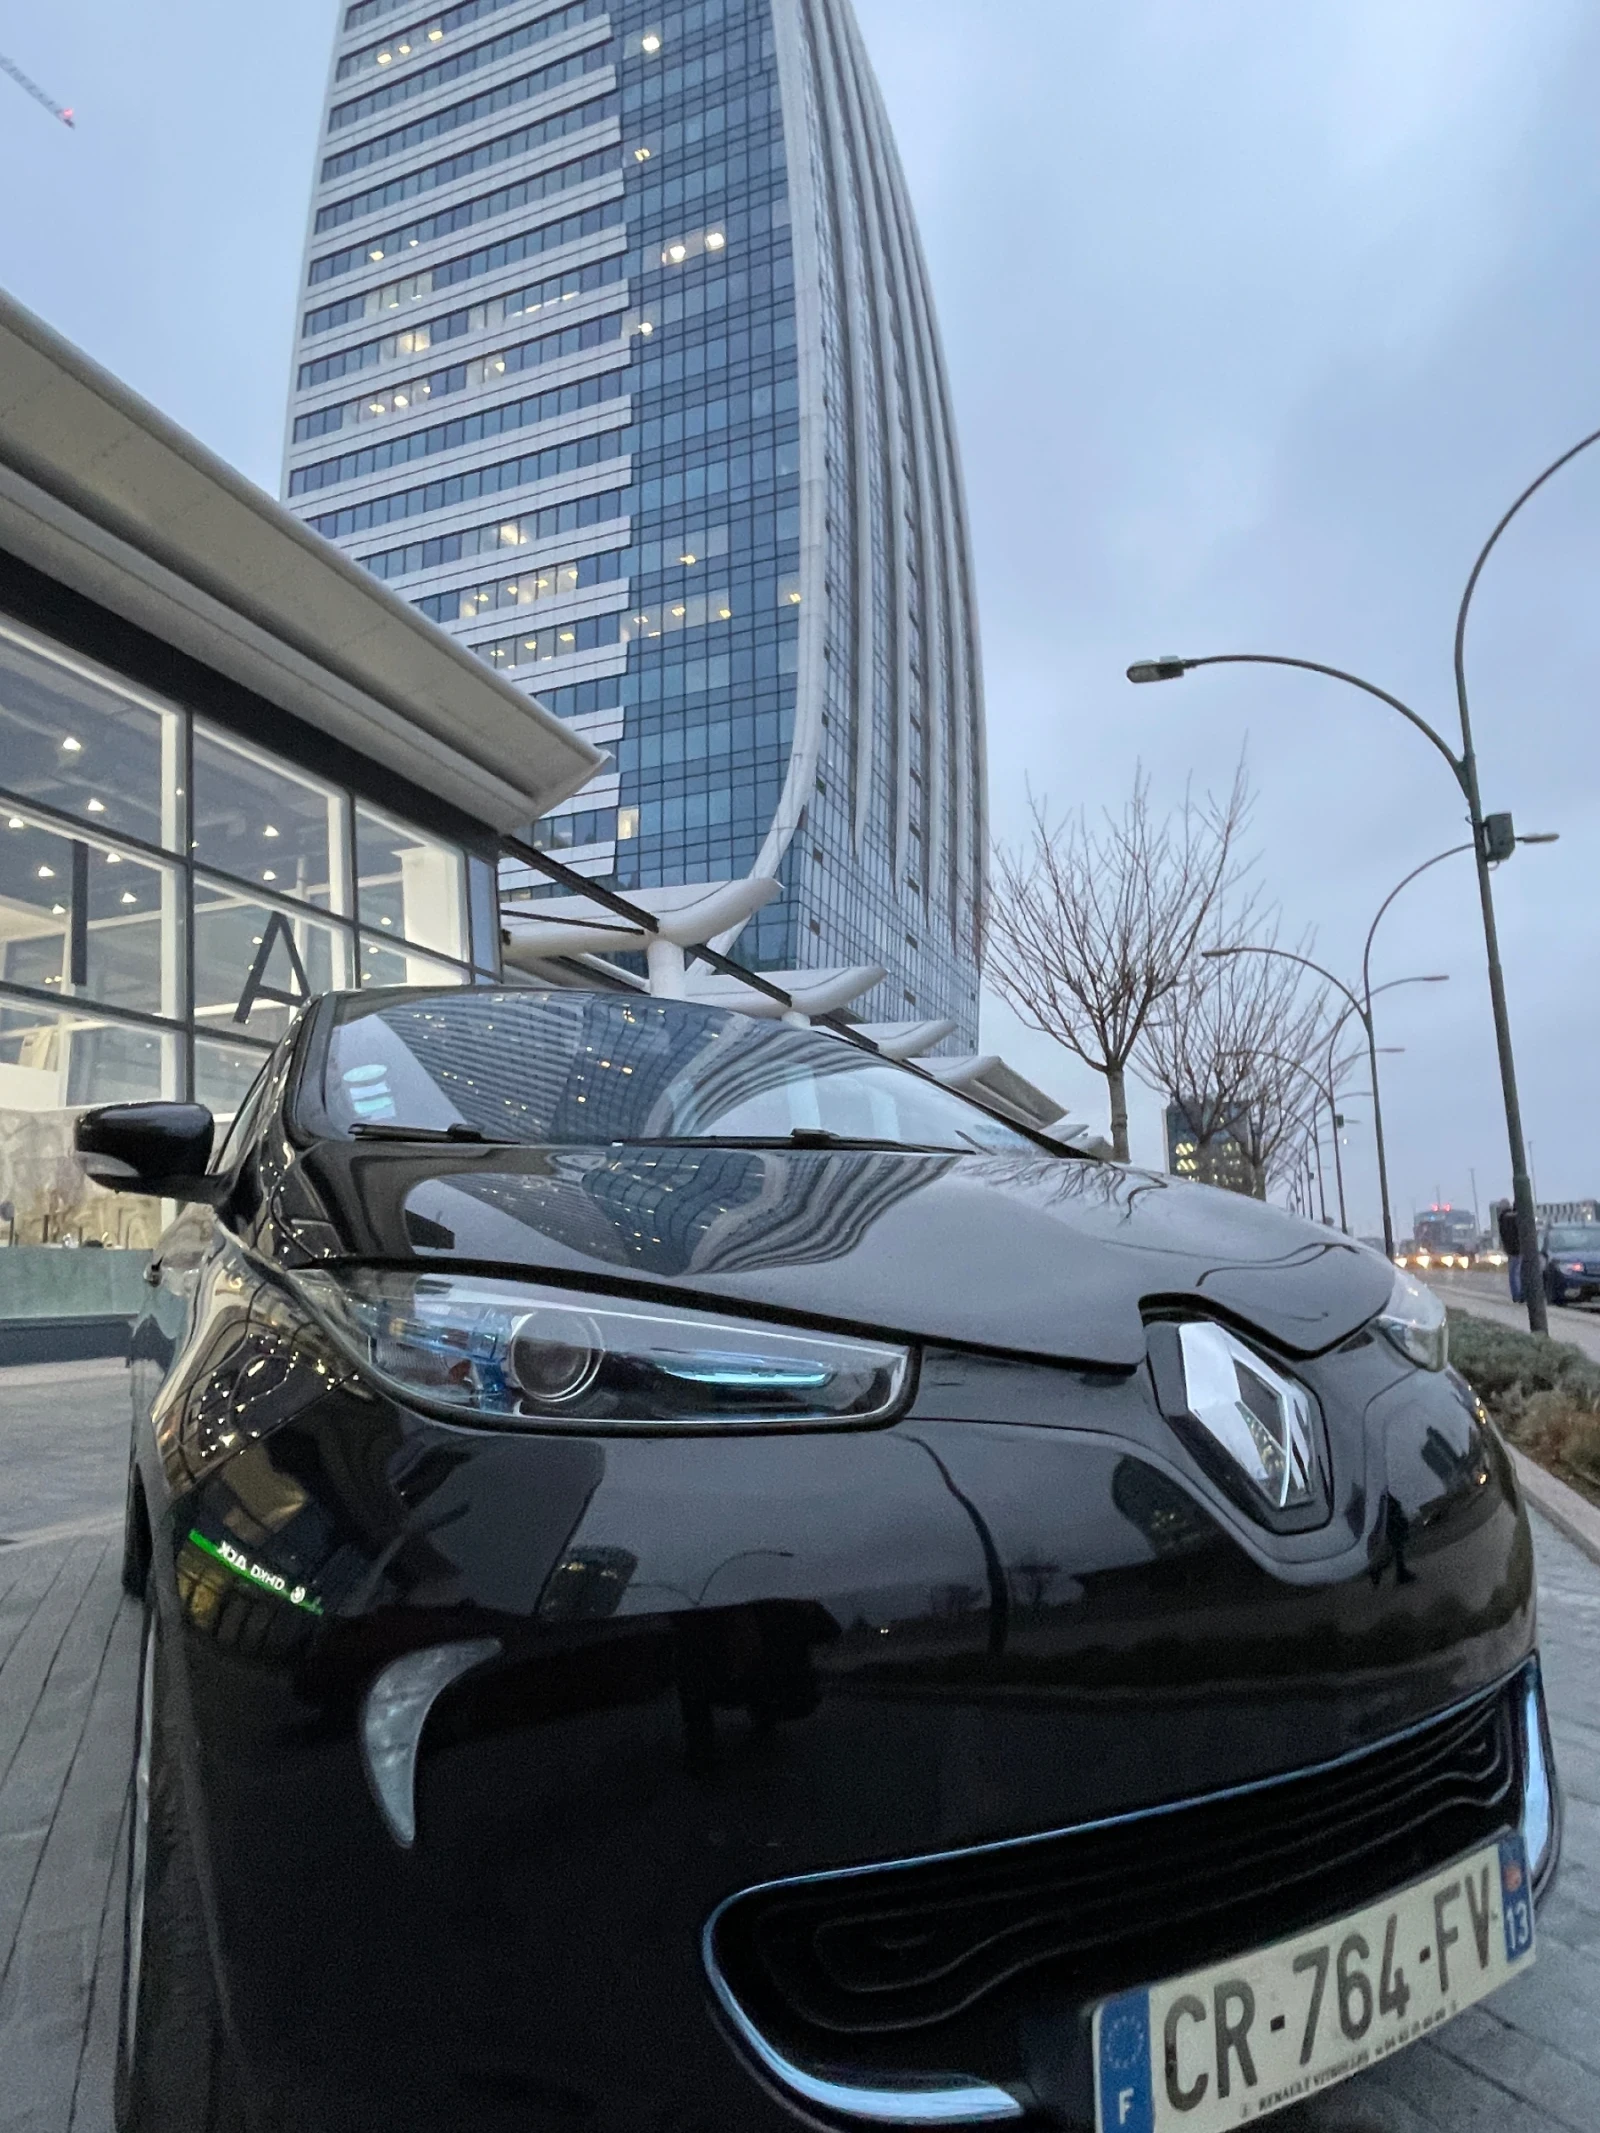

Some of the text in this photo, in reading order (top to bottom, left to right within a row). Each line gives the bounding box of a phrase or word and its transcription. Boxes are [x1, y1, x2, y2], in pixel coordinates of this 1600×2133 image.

[1505, 1903, 1533, 1950] 13
[1164, 1865, 1490, 2112] CR-764-FV
[1118, 2087, 1134, 2125] F
